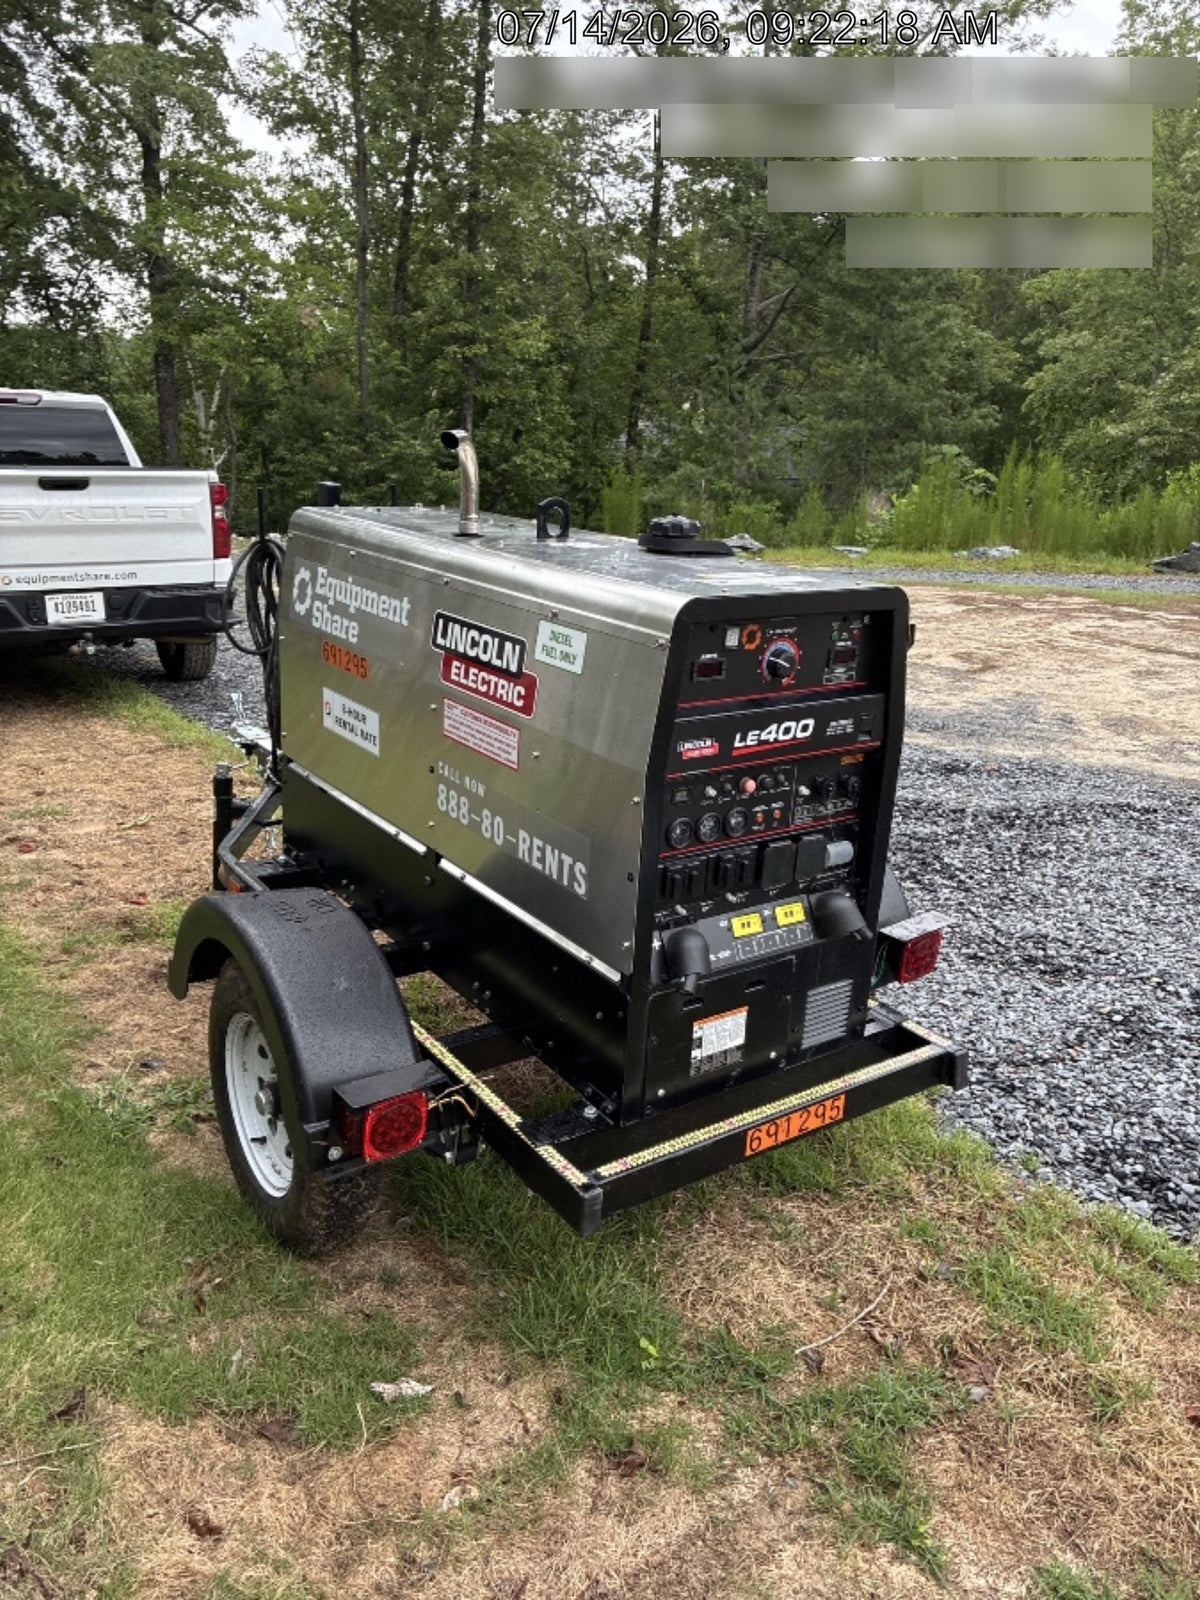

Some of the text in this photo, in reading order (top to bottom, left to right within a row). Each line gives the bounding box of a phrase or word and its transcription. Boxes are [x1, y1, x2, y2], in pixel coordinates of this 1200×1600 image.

[15, 571, 138, 586] equipmentshare.com
[315, 566, 411, 627] Equipment
[312, 600, 359, 644] Share
[549, 629, 573, 648] DIESEL
[322, 640, 367, 679] 691295
[436, 618, 520, 673] LINCOLN
[450, 660, 526, 707] ELECTRIC
[335, 715, 378, 747] RENTAL RATE
[734, 718, 815, 748] LE400
[438, 761, 486, 797] CALL NOW
[437, 784, 588, 895] 888-80-RENTS
[749, 1096, 842, 1153] 691295
